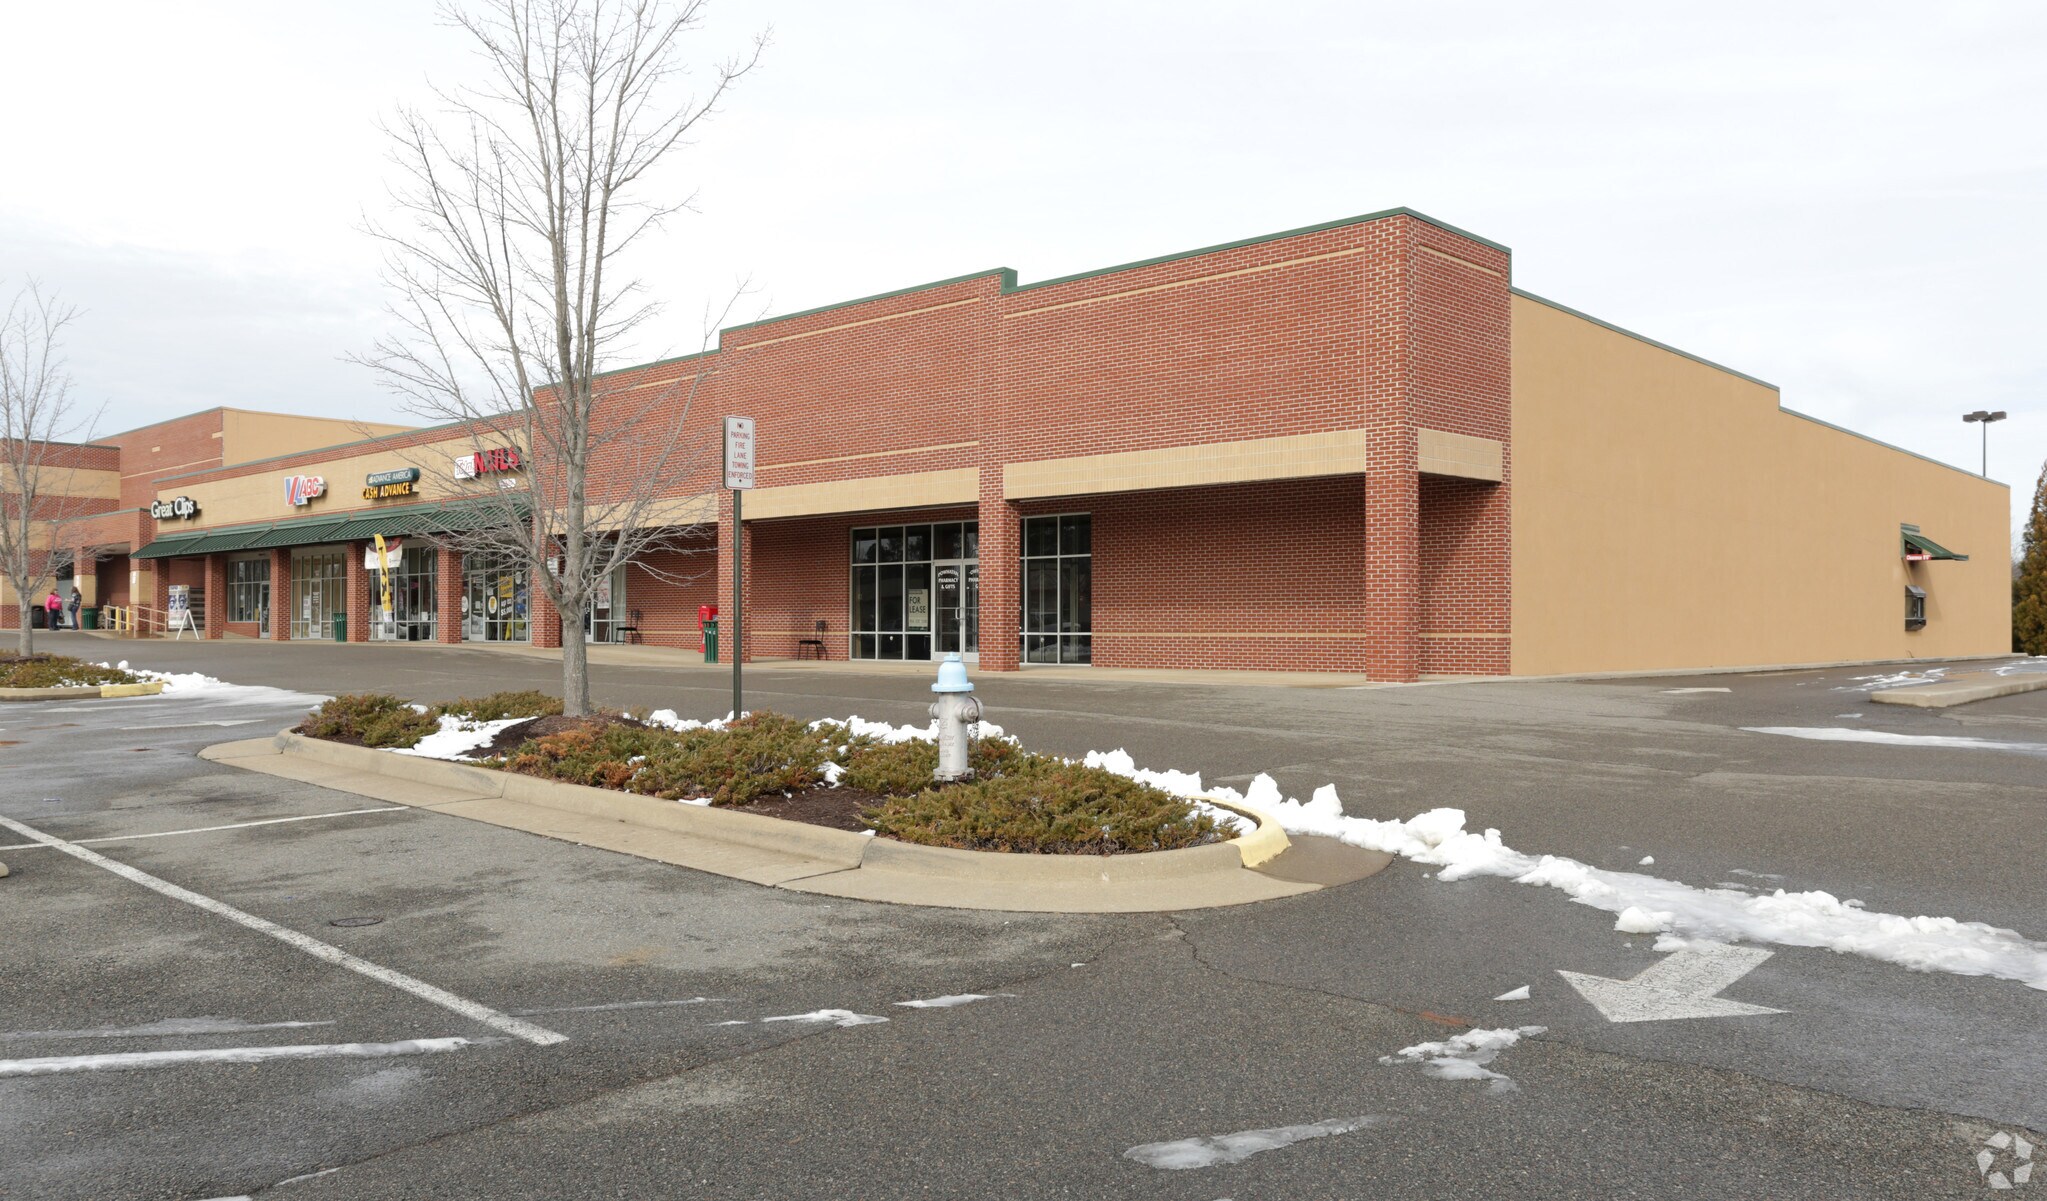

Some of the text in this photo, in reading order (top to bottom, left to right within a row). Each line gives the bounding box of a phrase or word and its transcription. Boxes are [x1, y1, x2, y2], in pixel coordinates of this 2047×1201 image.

[730, 431, 750, 440] PARKING
[735, 441, 746, 449] FIRE
[732, 461, 749, 469] TOWING
[373, 470, 411, 483] ADVANCE AMERICA
[728, 471, 752, 479] ENFORCED
[363, 482, 410, 499] CASH ADVANCE
[151, 497, 194, 519] Great Clips
[910, 596, 921, 604] FOR
[909, 605, 926, 613] LEASE
